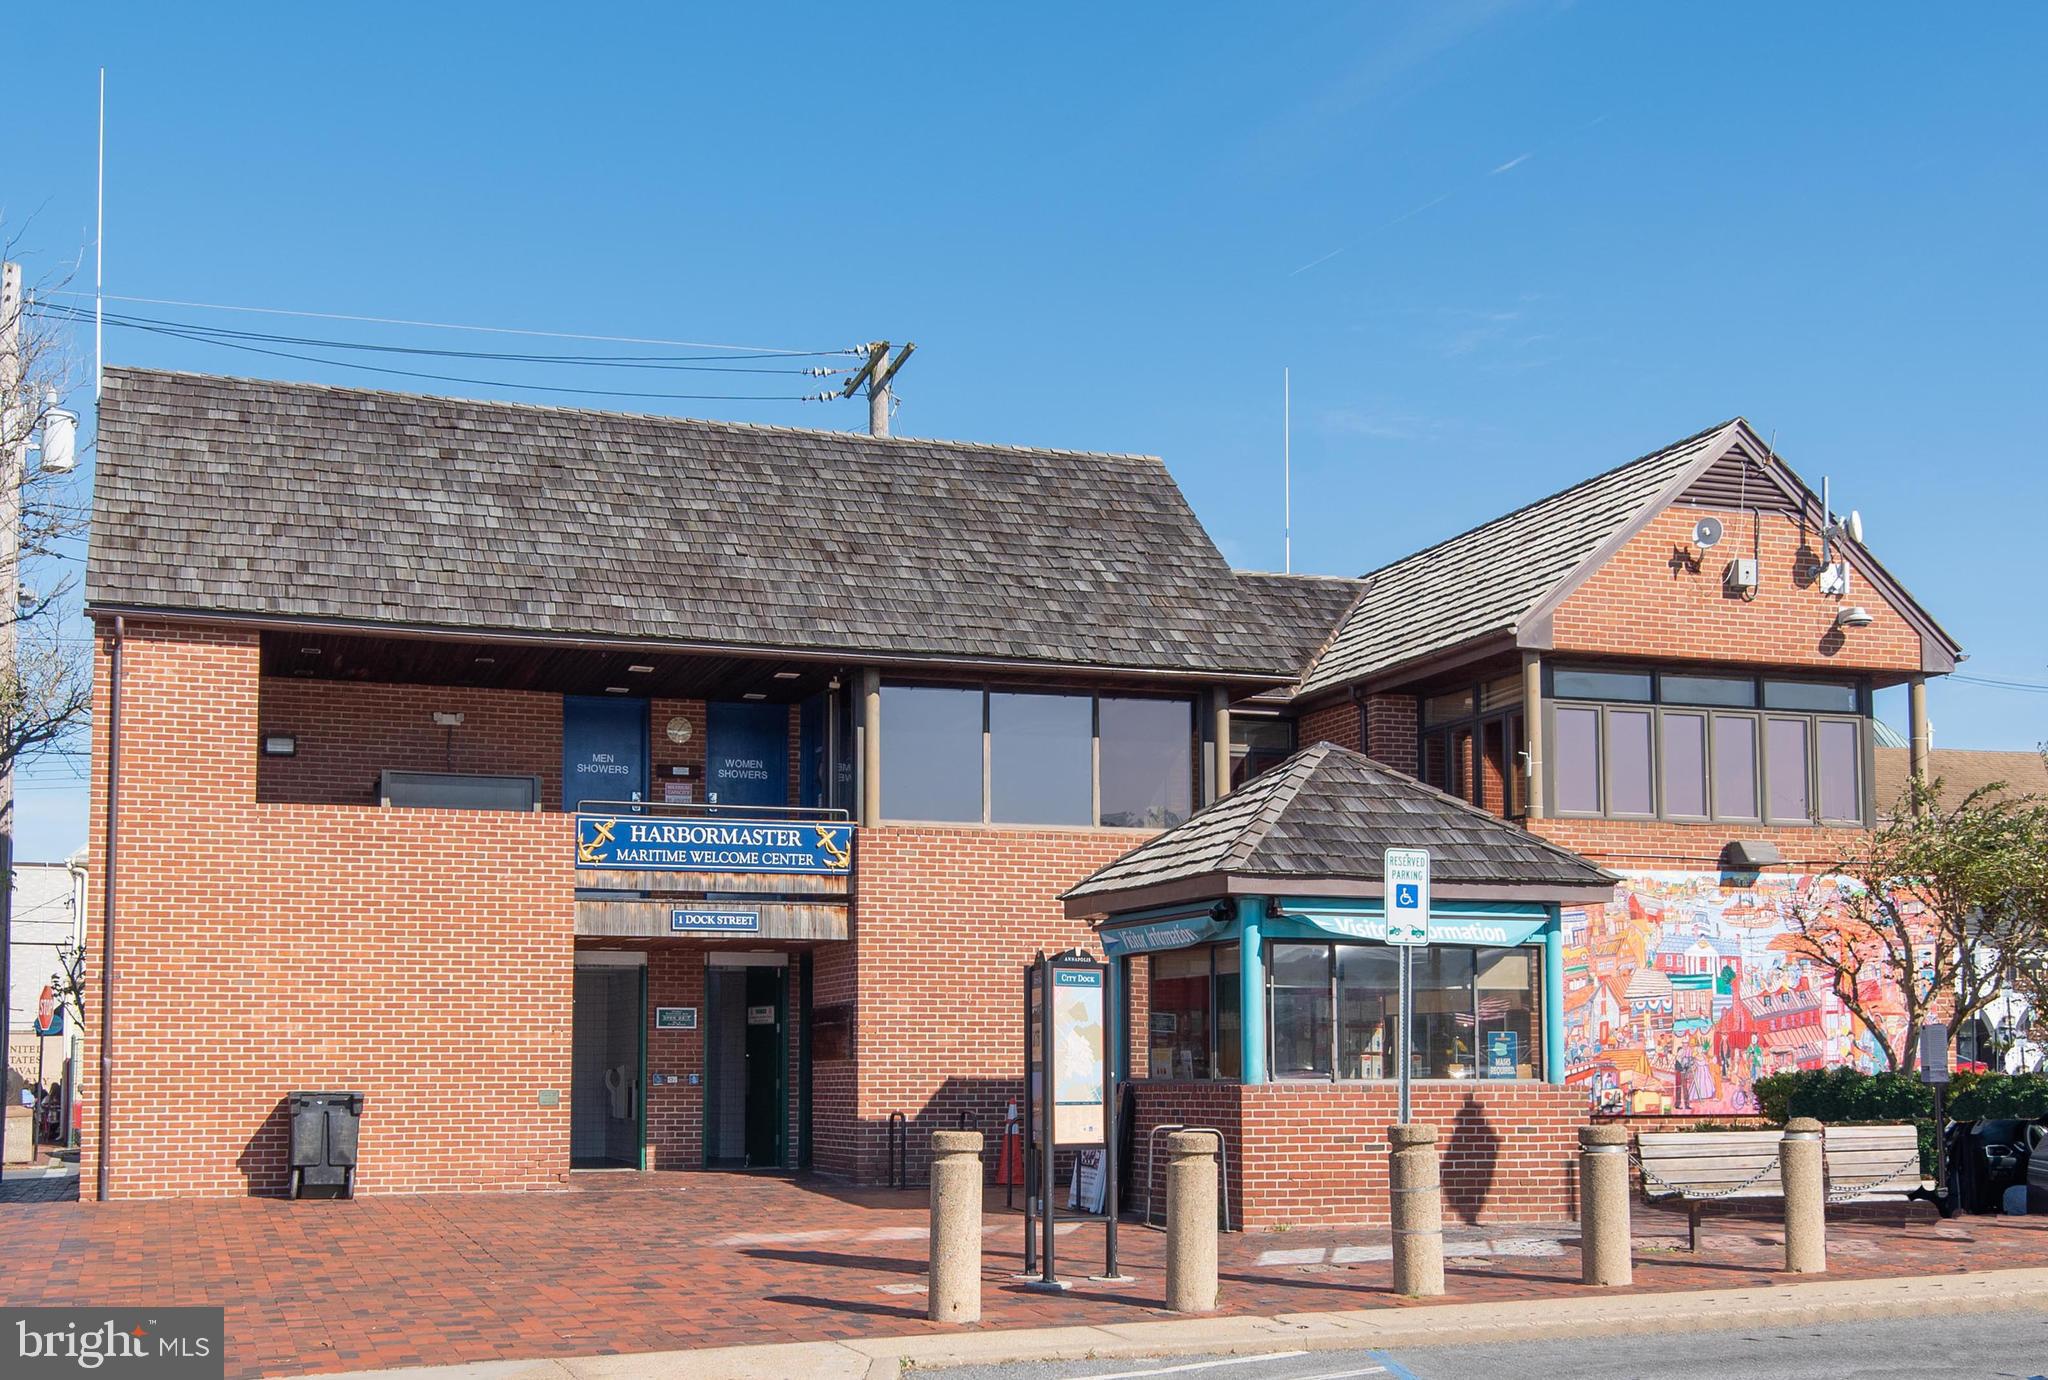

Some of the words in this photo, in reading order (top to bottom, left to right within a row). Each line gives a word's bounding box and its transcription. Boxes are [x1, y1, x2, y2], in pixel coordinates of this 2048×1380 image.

[592, 754, 614, 763] MEN
[725, 759, 763, 769] WOMEN
[576, 764, 629, 775] SHOWERS
[718, 769, 768, 780] SHOWERS
[630, 825, 803, 847] HARBORMASTER
[616, 849, 687, 862] MARITIME
[690, 851, 759, 865] WELCOME
[762, 853, 815, 866] CENTER
[1389, 856, 1425, 867] RESERVED
[1391, 870, 1423, 881] PARKING
[678, 915, 683, 924] 1
[685, 915, 715, 925] DOCK
[717, 916, 755, 926] STREET
[1333, 917, 1386, 938] Visito
[1429, 922, 1507, 943] ormation
[1118, 930, 1148, 950] Visitor
[1144, 924, 1199, 947] Information
[39, 999, 54, 1016] STOP
[10, 1045, 40, 1054] NITE
[10, 1056, 41, 1064] TATES
[16, 1066, 39, 1075] VAL
